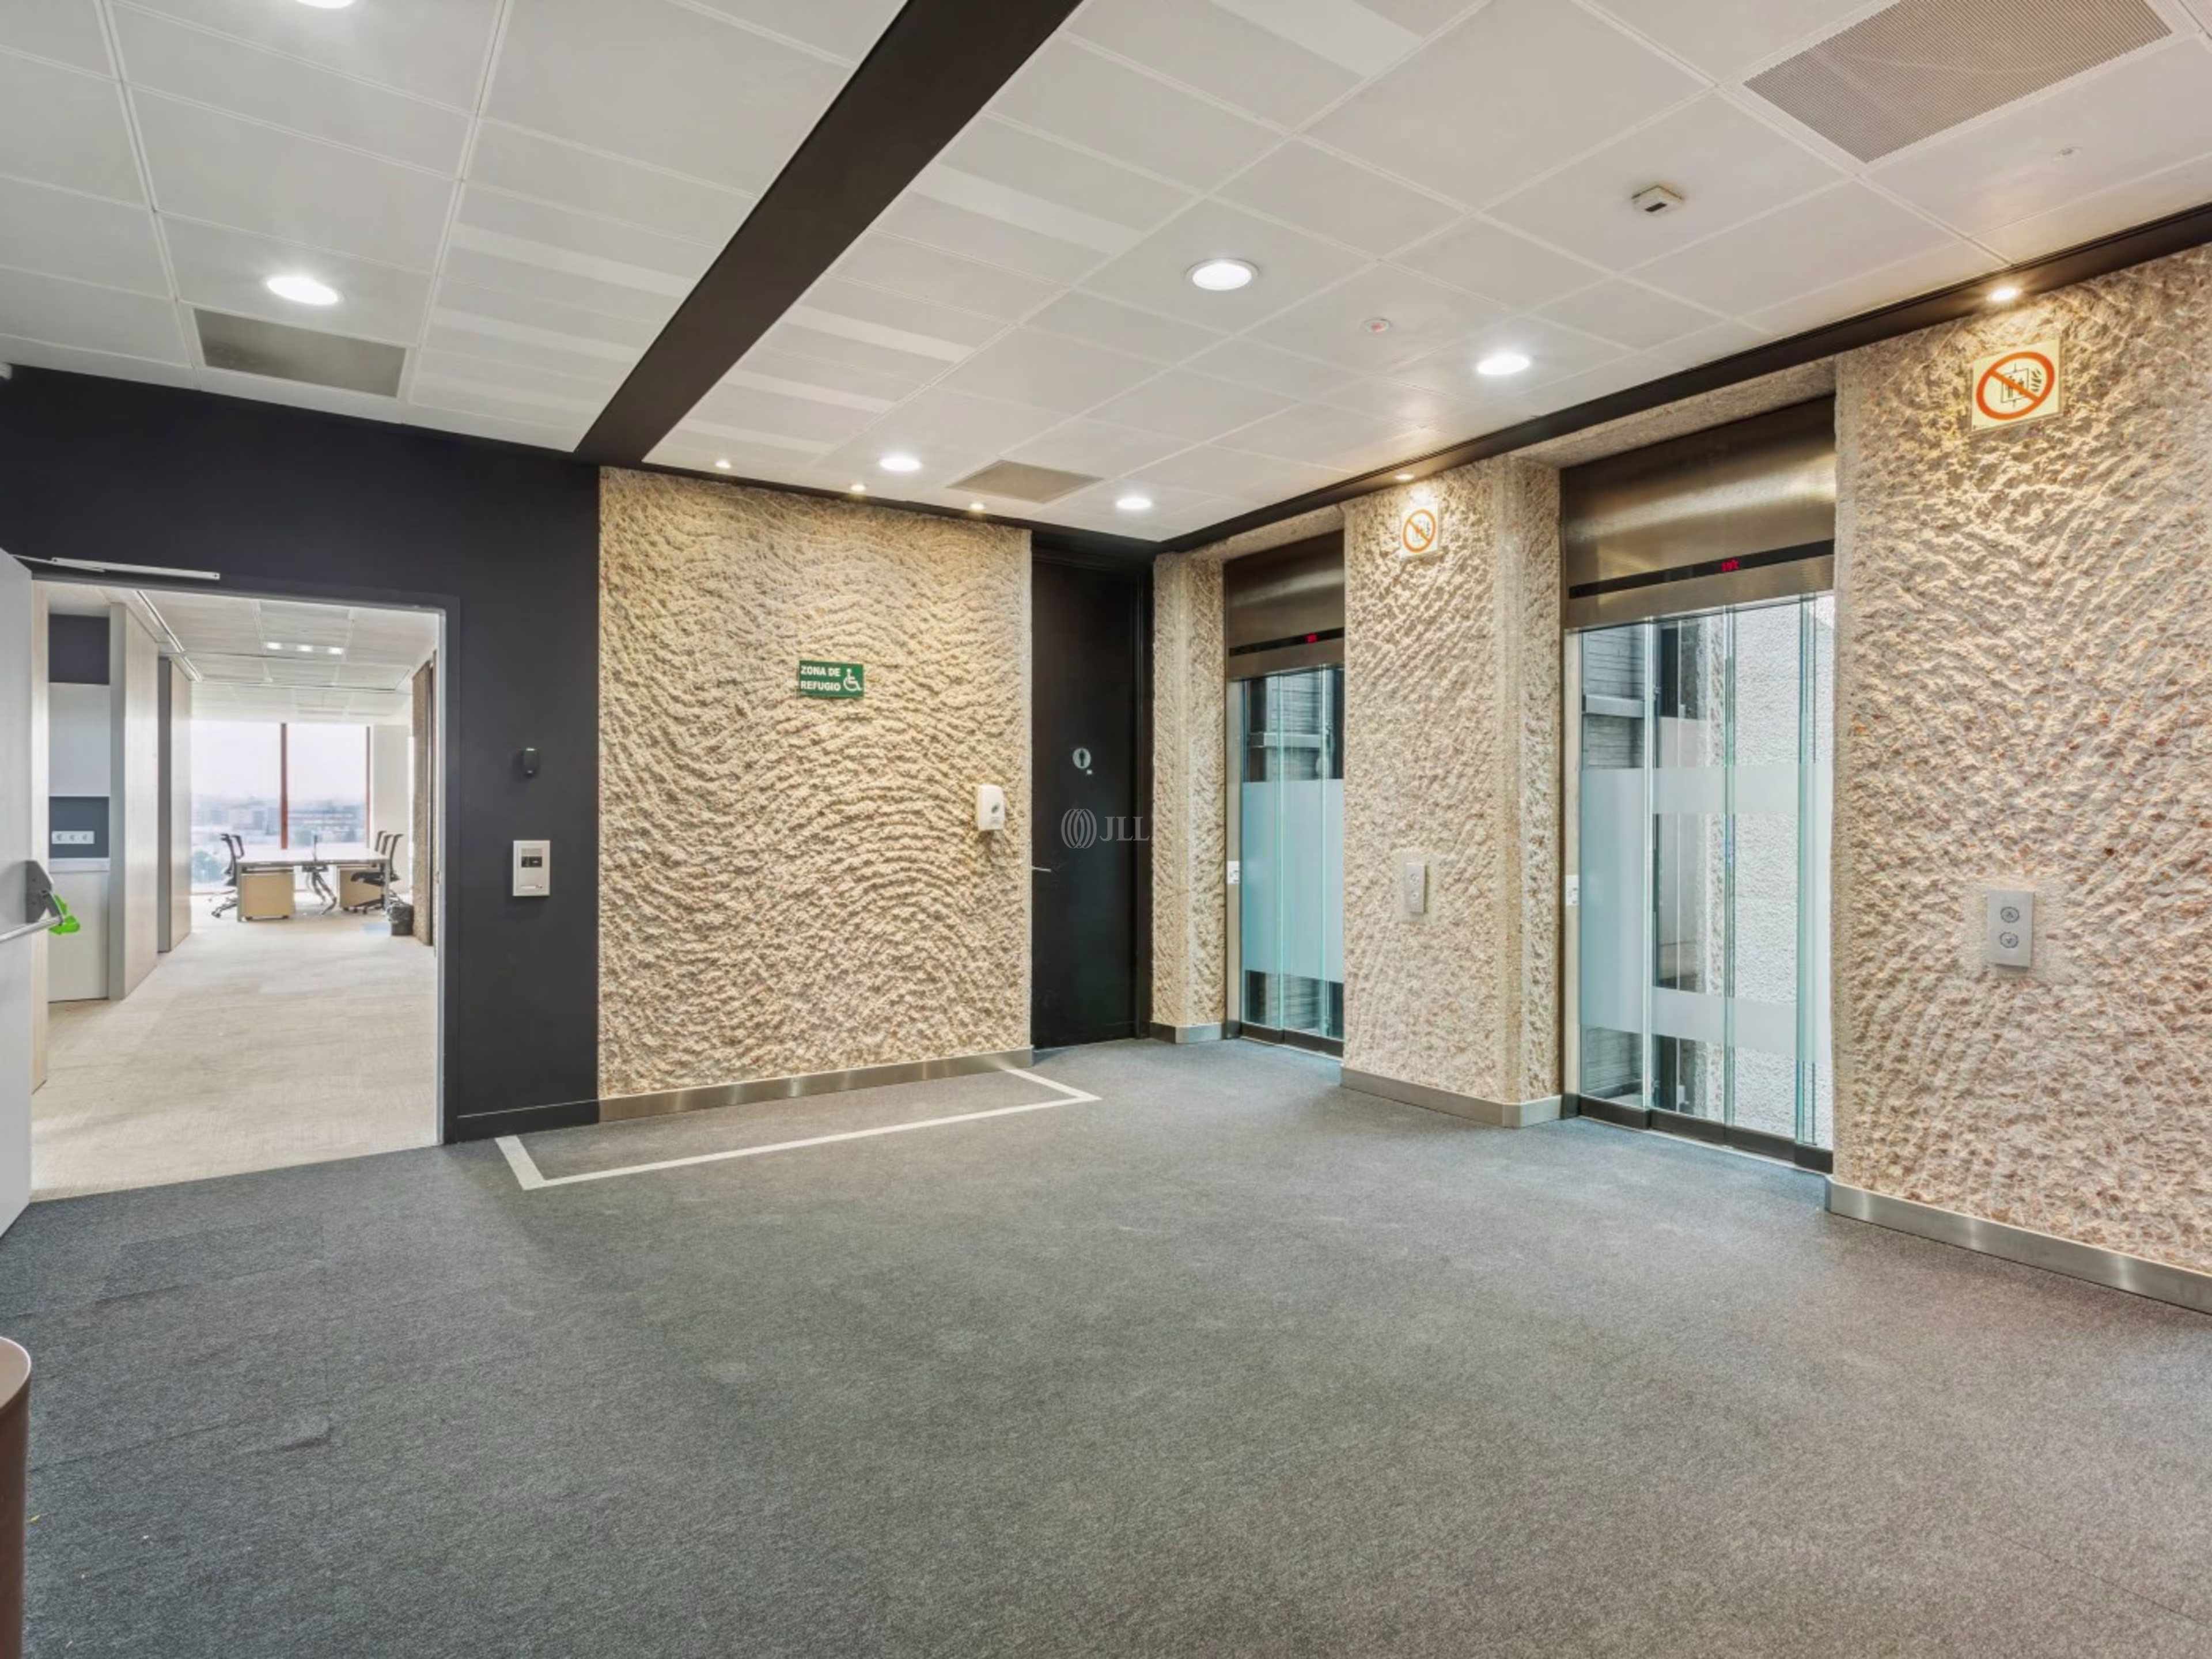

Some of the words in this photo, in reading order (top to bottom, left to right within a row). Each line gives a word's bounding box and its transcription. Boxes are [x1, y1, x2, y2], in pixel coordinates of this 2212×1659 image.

[800, 665, 826, 676] ZONA
[828, 668, 841, 677] DE
[800, 680, 841, 691] REFUGIO
